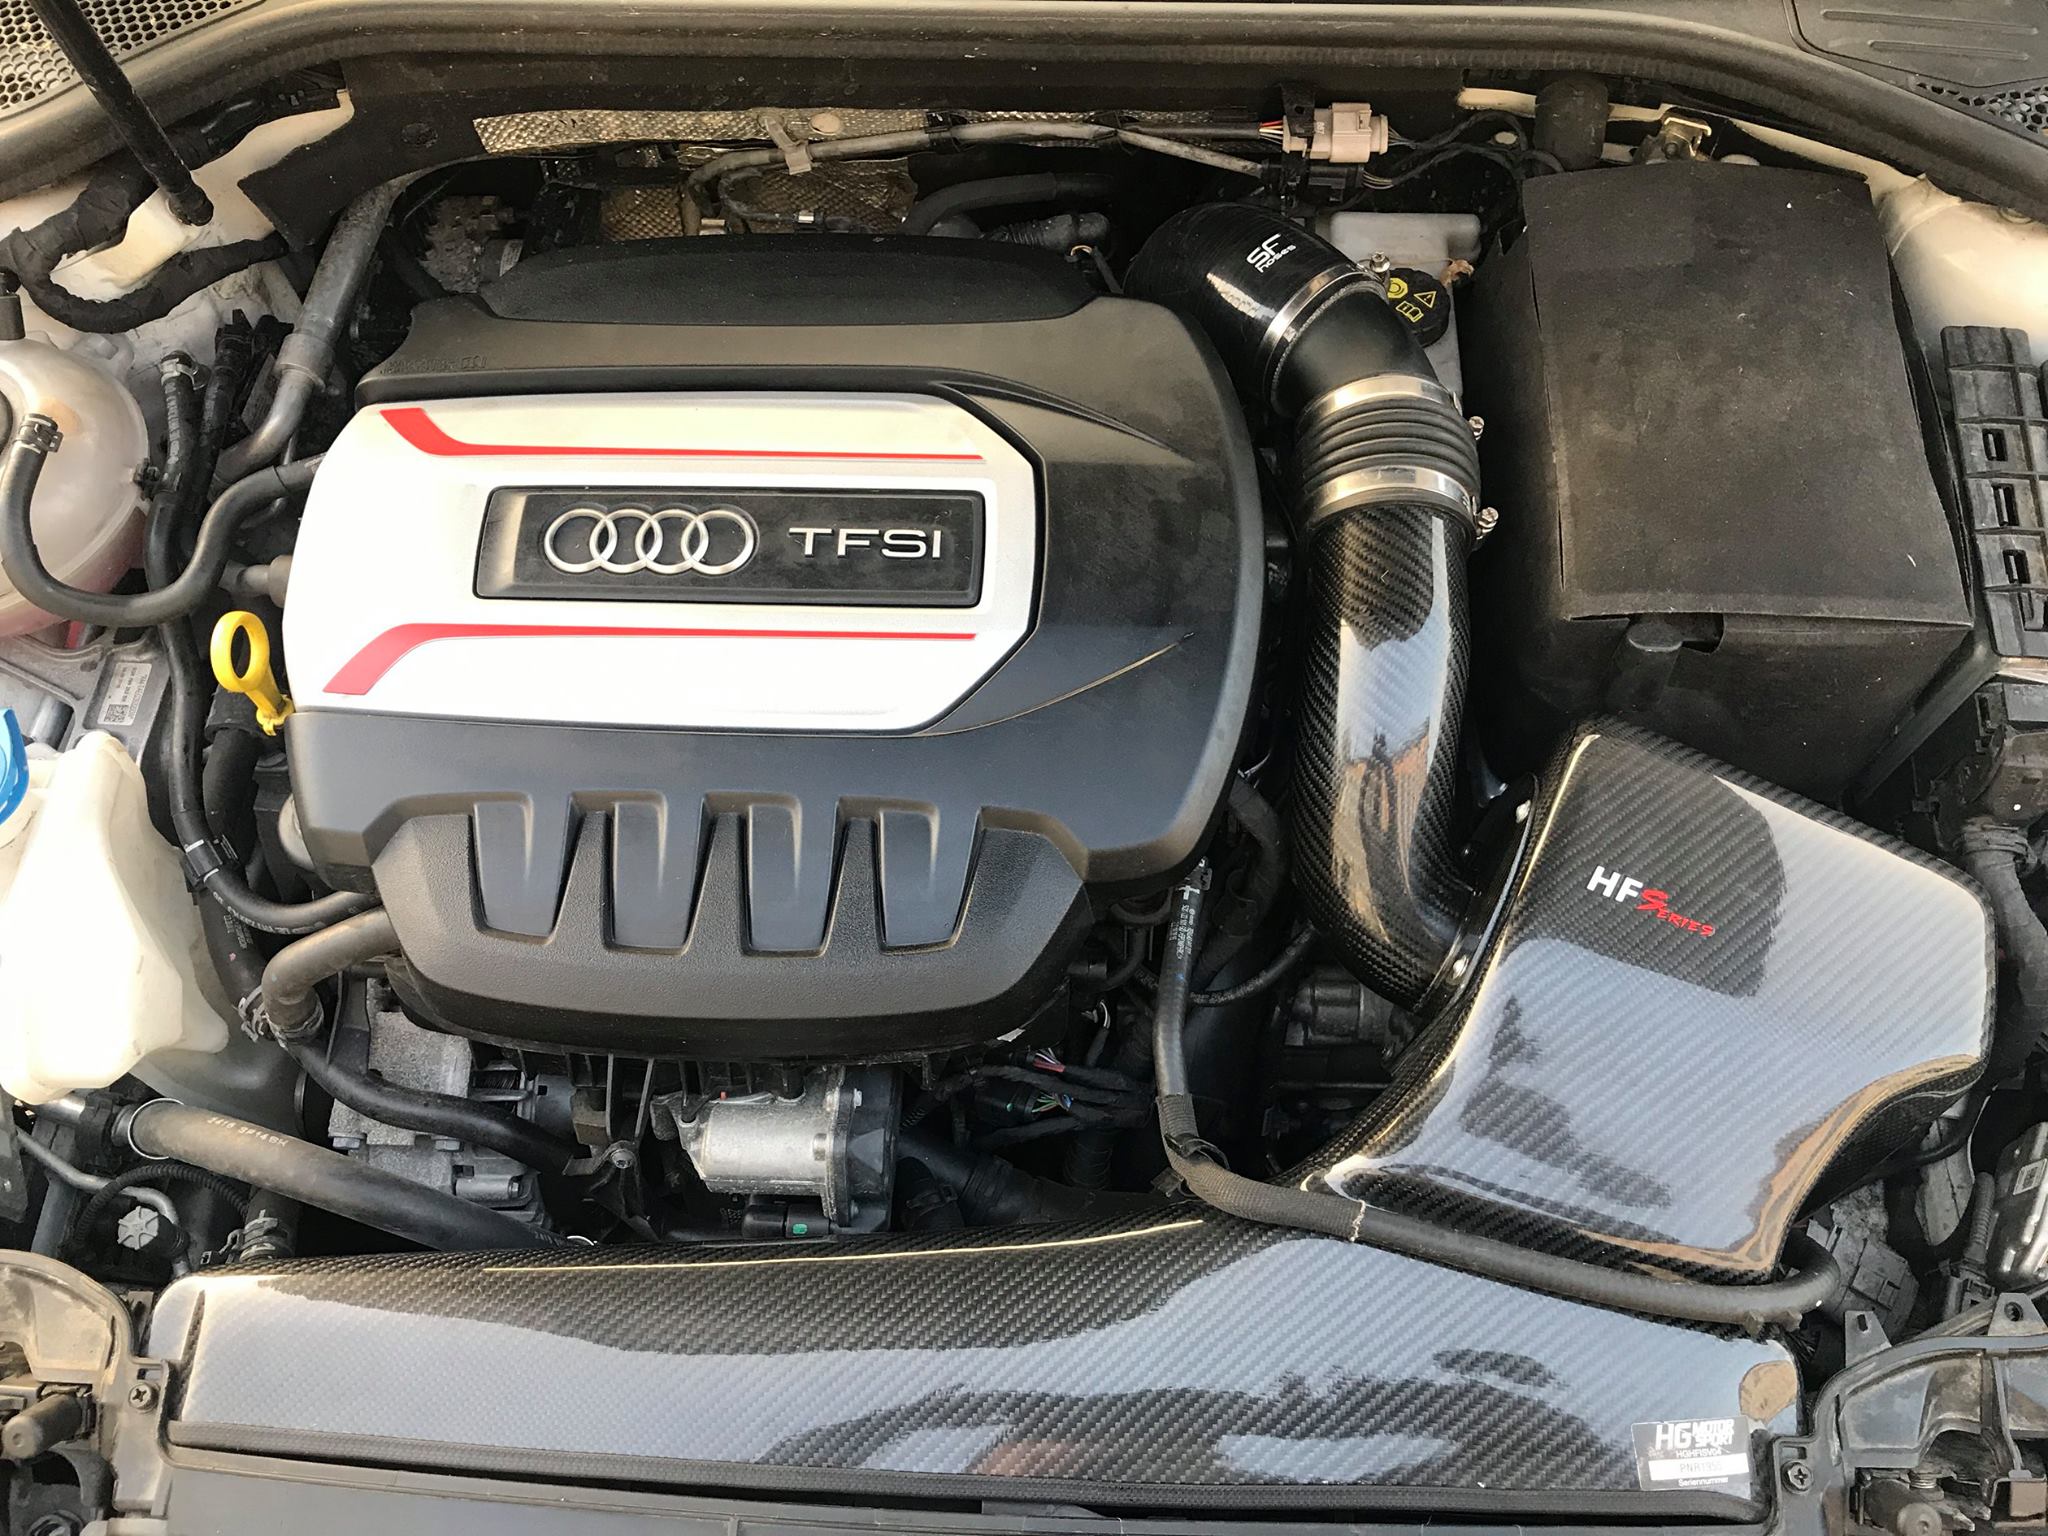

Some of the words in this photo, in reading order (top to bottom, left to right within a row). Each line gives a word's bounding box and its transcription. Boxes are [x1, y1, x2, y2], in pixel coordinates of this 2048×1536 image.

[1246, 233, 1281, 268] SF
[1257, 245, 1296, 273] hoses
[788, 527, 942, 559] TFSI
[1586, 865, 1643, 902] HF
[1655, 1422, 1692, 1450] HG
[1692, 1419, 1734, 1437] MOTOR
[1695, 1431, 1734, 1448] SPORT
